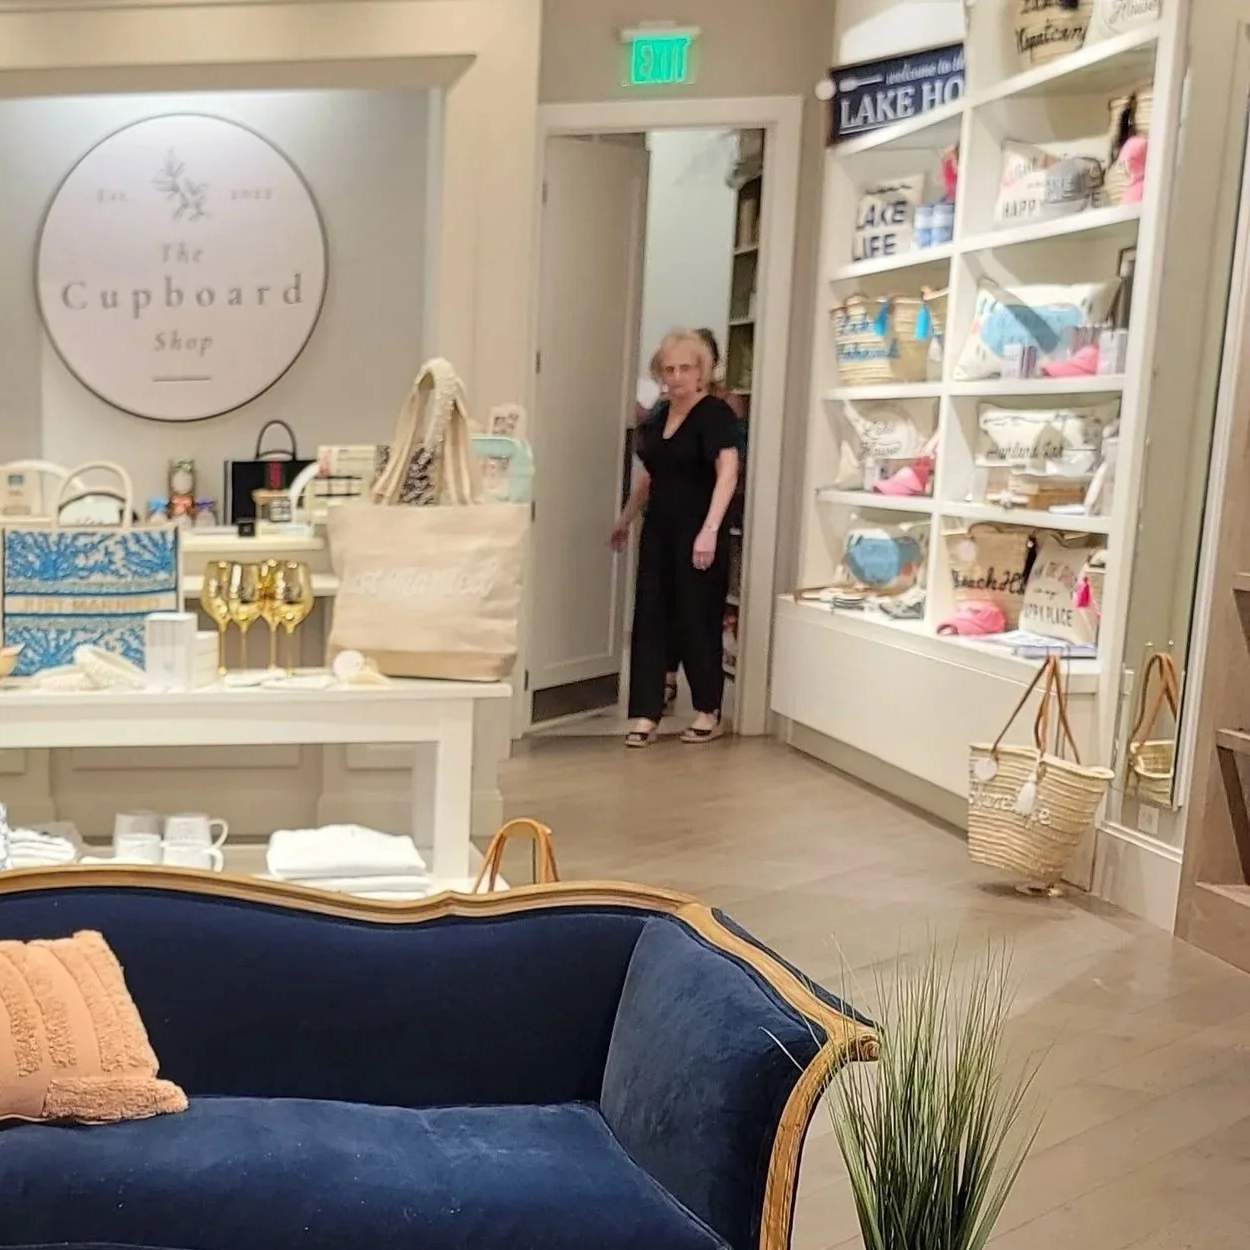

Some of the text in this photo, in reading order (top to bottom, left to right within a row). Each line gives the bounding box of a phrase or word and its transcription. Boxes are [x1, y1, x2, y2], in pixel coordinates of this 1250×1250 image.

[637, 40, 689, 83] EXIT
[840, 77, 965, 126] LAKE HO
[855, 200, 907, 232] LAKE
[161, 243, 204, 264] The
[851, 233, 897, 262] LIFE
[61, 272, 303, 320] Cupboard
[154, 329, 213, 357] Shop
